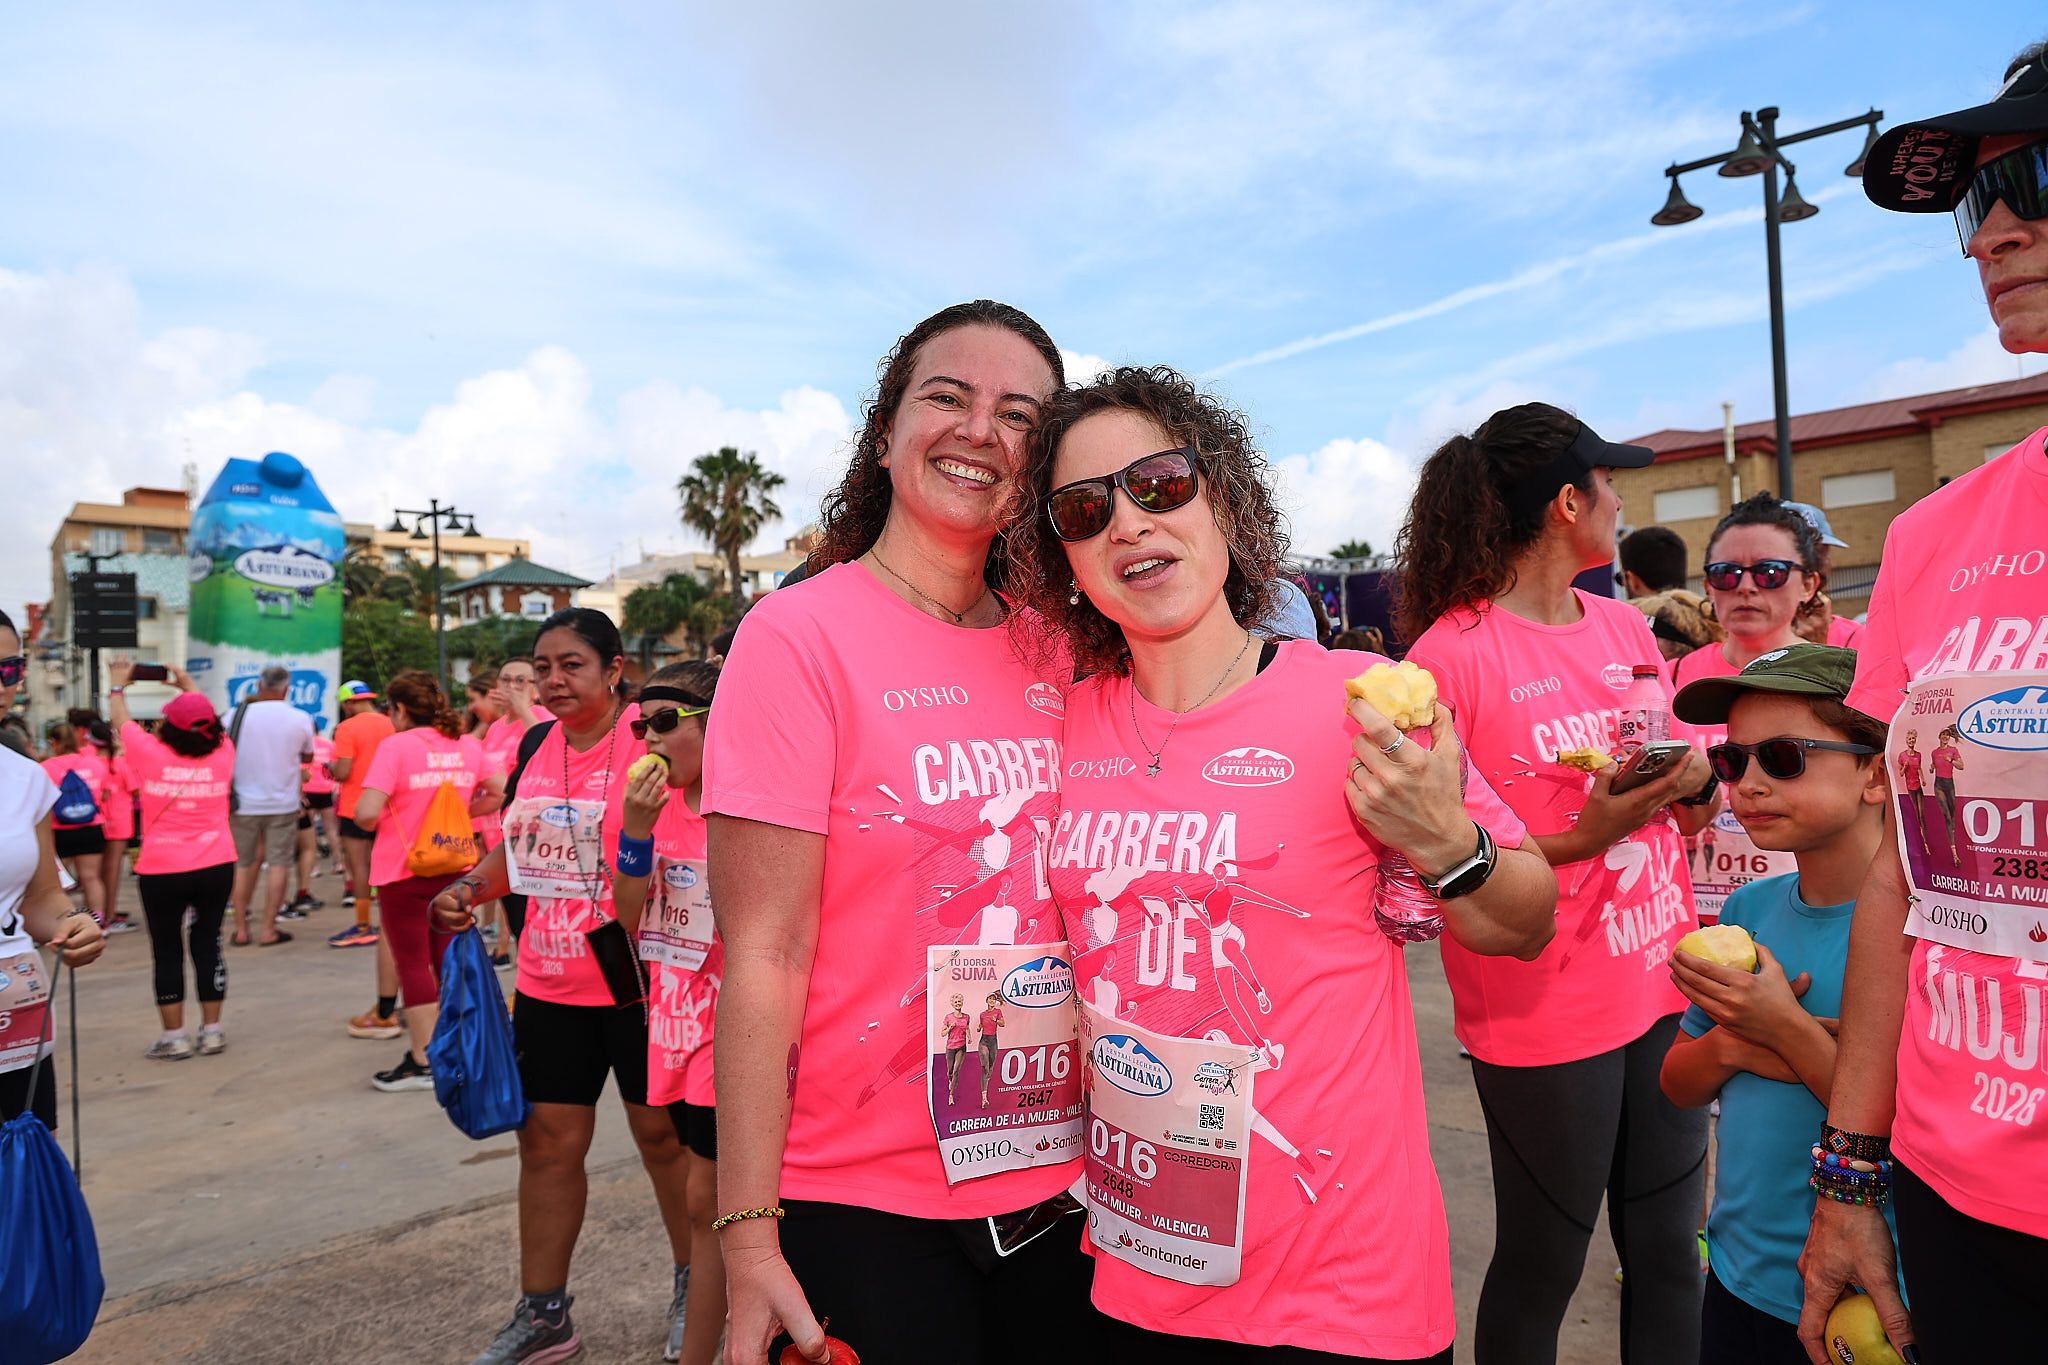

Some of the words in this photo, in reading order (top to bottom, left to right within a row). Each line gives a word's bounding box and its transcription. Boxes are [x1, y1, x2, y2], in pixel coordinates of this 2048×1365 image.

[884, 684, 969, 711] OYSHO
[1510, 676, 1562, 703] OYSHO
[1911, 698, 1954, 716] SUMA
[1531, 708, 1621, 763] CARRE
[912, 737, 1063, 805] CARRER
[1206, 762, 1286, 778] ASTURIANA
[1963, 800, 2048, 847] 01
[1049, 810, 1239, 877] CARRERA
[1998, 848, 2038, 857] VIOLENCIA
[1717, 853, 1769, 873] 016
[1931, 873, 1969, 894] CARRERA
[1970, 881, 1980, 896] DE
[1985, 883, 2005, 899] LA
[665, 905, 689, 926] 016
[1606, 883, 1690, 957] MUJER
[1931, 905, 1988, 935] OYSHO
[1135, 896, 1204, 992] DE
[1644, 939, 1668, 972] 2026
[951, 967, 998, 981] SUMA
[963, 958, 997, 967] DORSAL
[1008, 978, 1072, 998] ASTURIANA
[1001, 1044, 1071, 1085] 016
[1096, 1044, 1164, 1091] ASTURIANA
[1017, 1090, 1054, 1108] 2647
[1970, 1072, 2046, 1127] 2026
[949, 1117, 992, 1134] CARRERA
[996, 1114, 1010, 1127] DE
[1012, 1113, 1025, 1125] LA
[1028, 1109, 1060, 1123] MUJER
[951, 1139, 1012, 1166] OYSHO
[1091, 1118, 1157, 1180] 016
[1164, 1151, 1236, 1172] CORREDORA
[1102, 1169, 1134, 1199] 2648
[1098, 1188, 1109, 1205] LA
[1110, 1196, 1142, 1221] MUJER
[1151, 1213, 1210, 1239] VALENCIA
[1134, 1238, 1208, 1271] Santander
